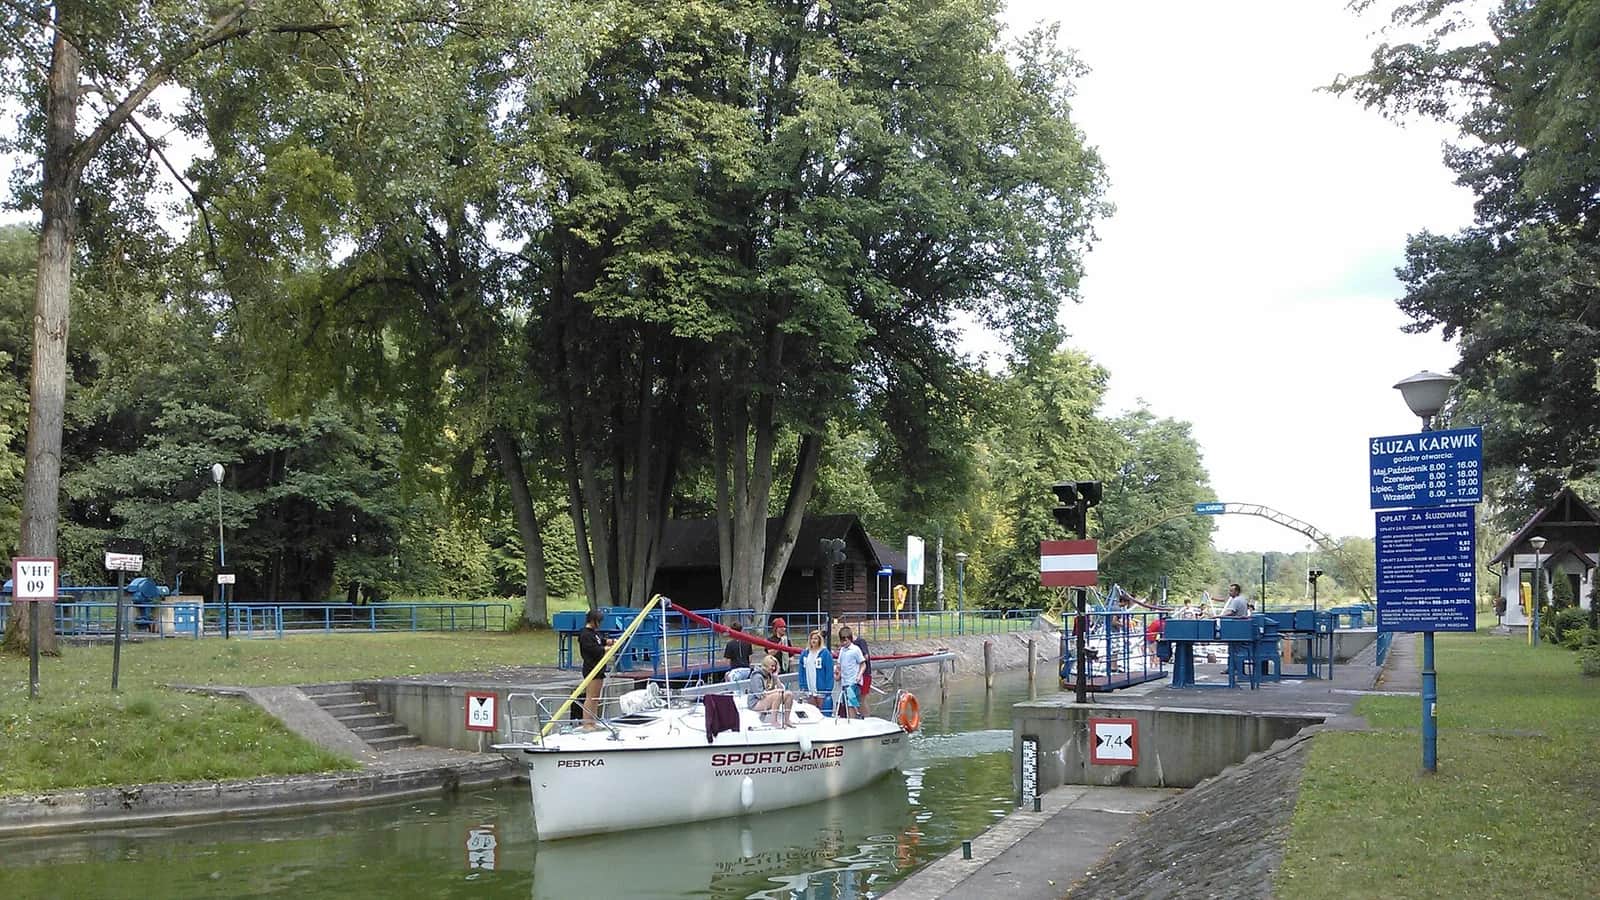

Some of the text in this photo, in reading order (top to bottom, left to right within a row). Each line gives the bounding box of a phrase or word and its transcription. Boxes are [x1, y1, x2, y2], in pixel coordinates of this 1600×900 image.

[1372, 434, 1478, 455] ŚLUZA KARWIK
[1393, 455, 1420, 464] godziny
[1429, 463, 1446, 471] 8.00
[1382, 475, 1415, 484] Czerwiec
[1429, 472, 1446, 480] 8.00
[1397, 481, 1427, 491] Sierpień
[1429, 480, 1446, 489] 8.00
[1383, 491, 1416, 501] Wrzesień
[1429, 489, 1446, 498] 8.00
[1457, 488, 1479, 496] 17.00
[1380, 514, 1407, 522] OPŁATY
[1425, 510, 1468, 520] ŚLUZOWANIE
[20, 565, 52, 577] VHF
[27, 580, 45, 593] 09
[473, 710, 489, 721] 6,5
[1103, 734, 1123, 749] 7,4
[557, 758, 605, 768] PESTKA
